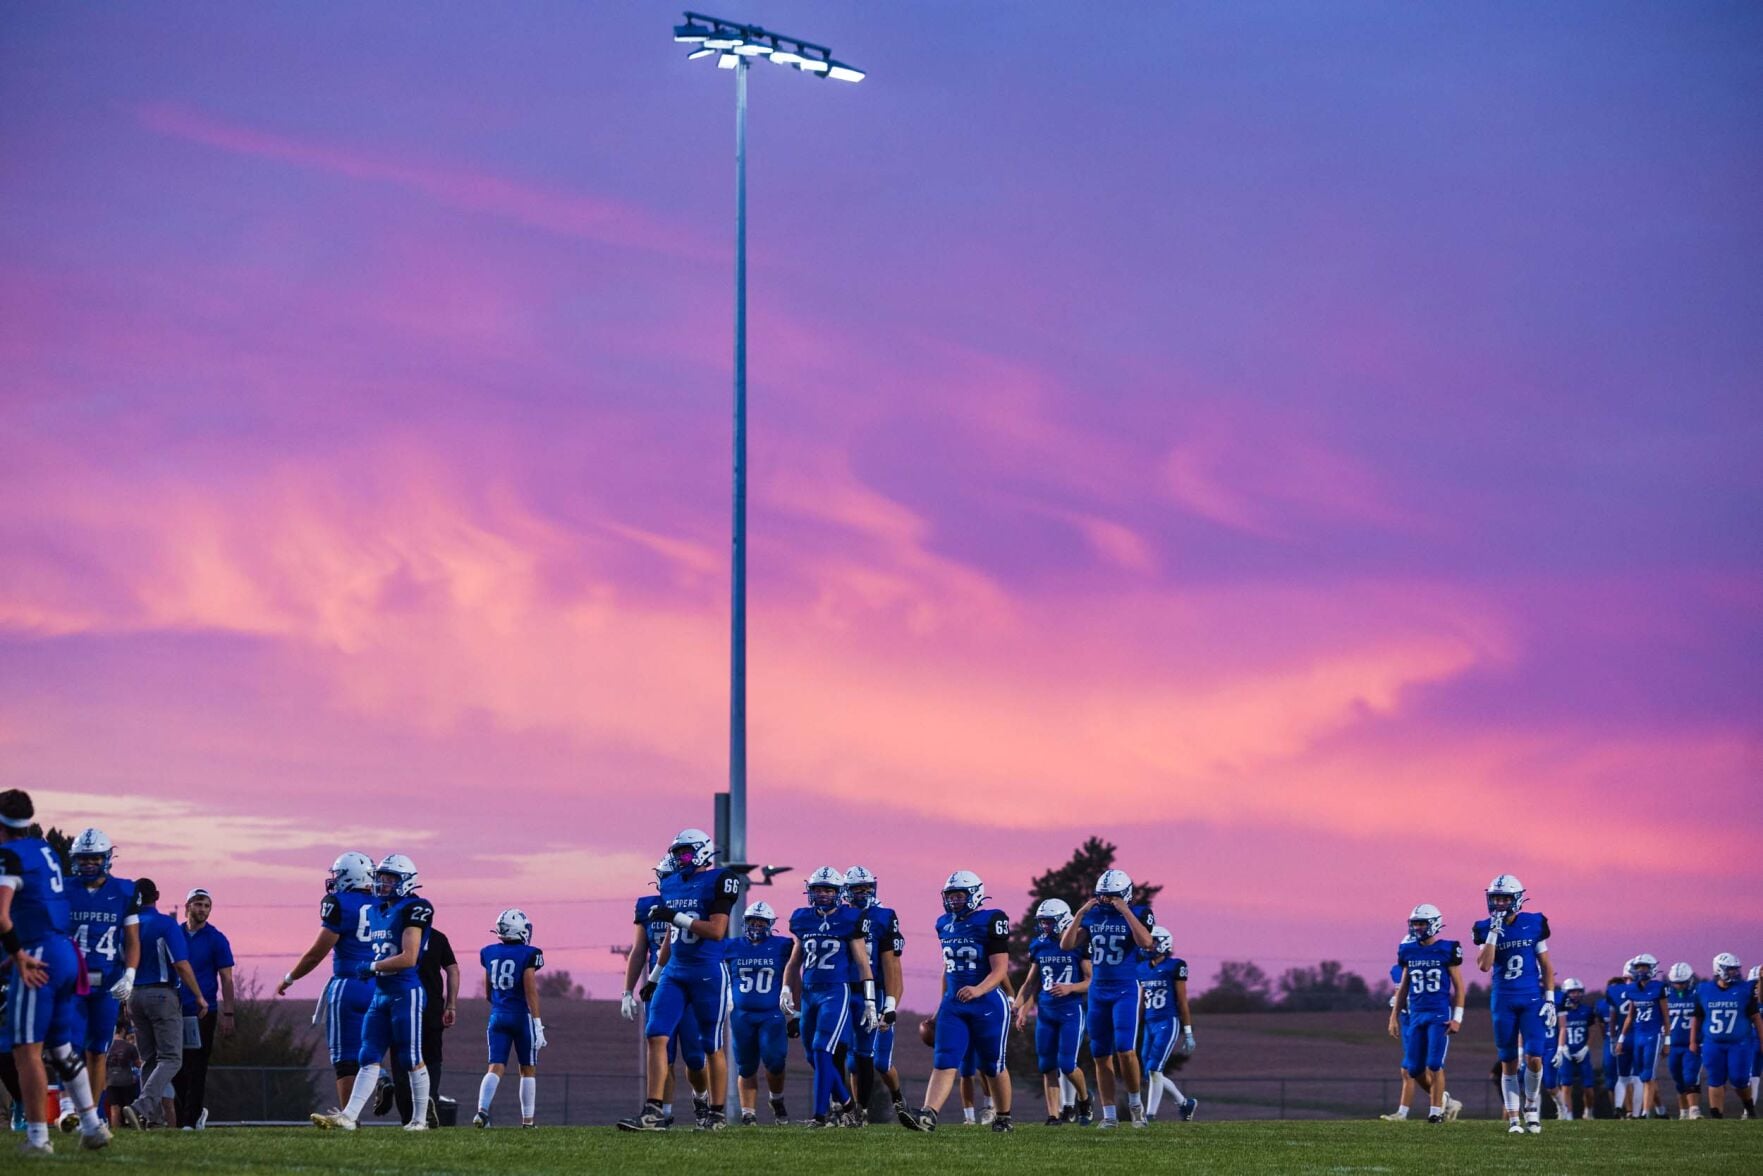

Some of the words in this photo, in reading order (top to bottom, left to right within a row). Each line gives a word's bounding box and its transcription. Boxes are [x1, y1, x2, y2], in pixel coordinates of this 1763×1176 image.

[40, 846, 64, 893] 5
[723, 878, 740, 894] 66
[321, 902, 335, 918] 67
[410, 905, 433, 922] 22
[665, 898, 698, 909] CLIPPERS
[356, 904, 373, 942] 6
[995, 920, 1009, 935] 63
[1089, 923, 1127, 934] CLIPPERS
[74, 924, 117, 961] 44
[803, 938, 841, 970] 82
[1090, 935, 1126, 965] 65
[737, 958, 774, 966] CLIPPERS
[942, 946, 978, 973] 63
[1504, 954, 1524, 980] 8
[490, 958, 516, 991] 18
[738, 967, 776, 994] 50
[1042, 965, 1073, 991] 84
[1668, 1008, 1695, 1031] 75
[1709, 1009, 1738, 1034] 57
[1566, 1026, 1585, 1045] 16
